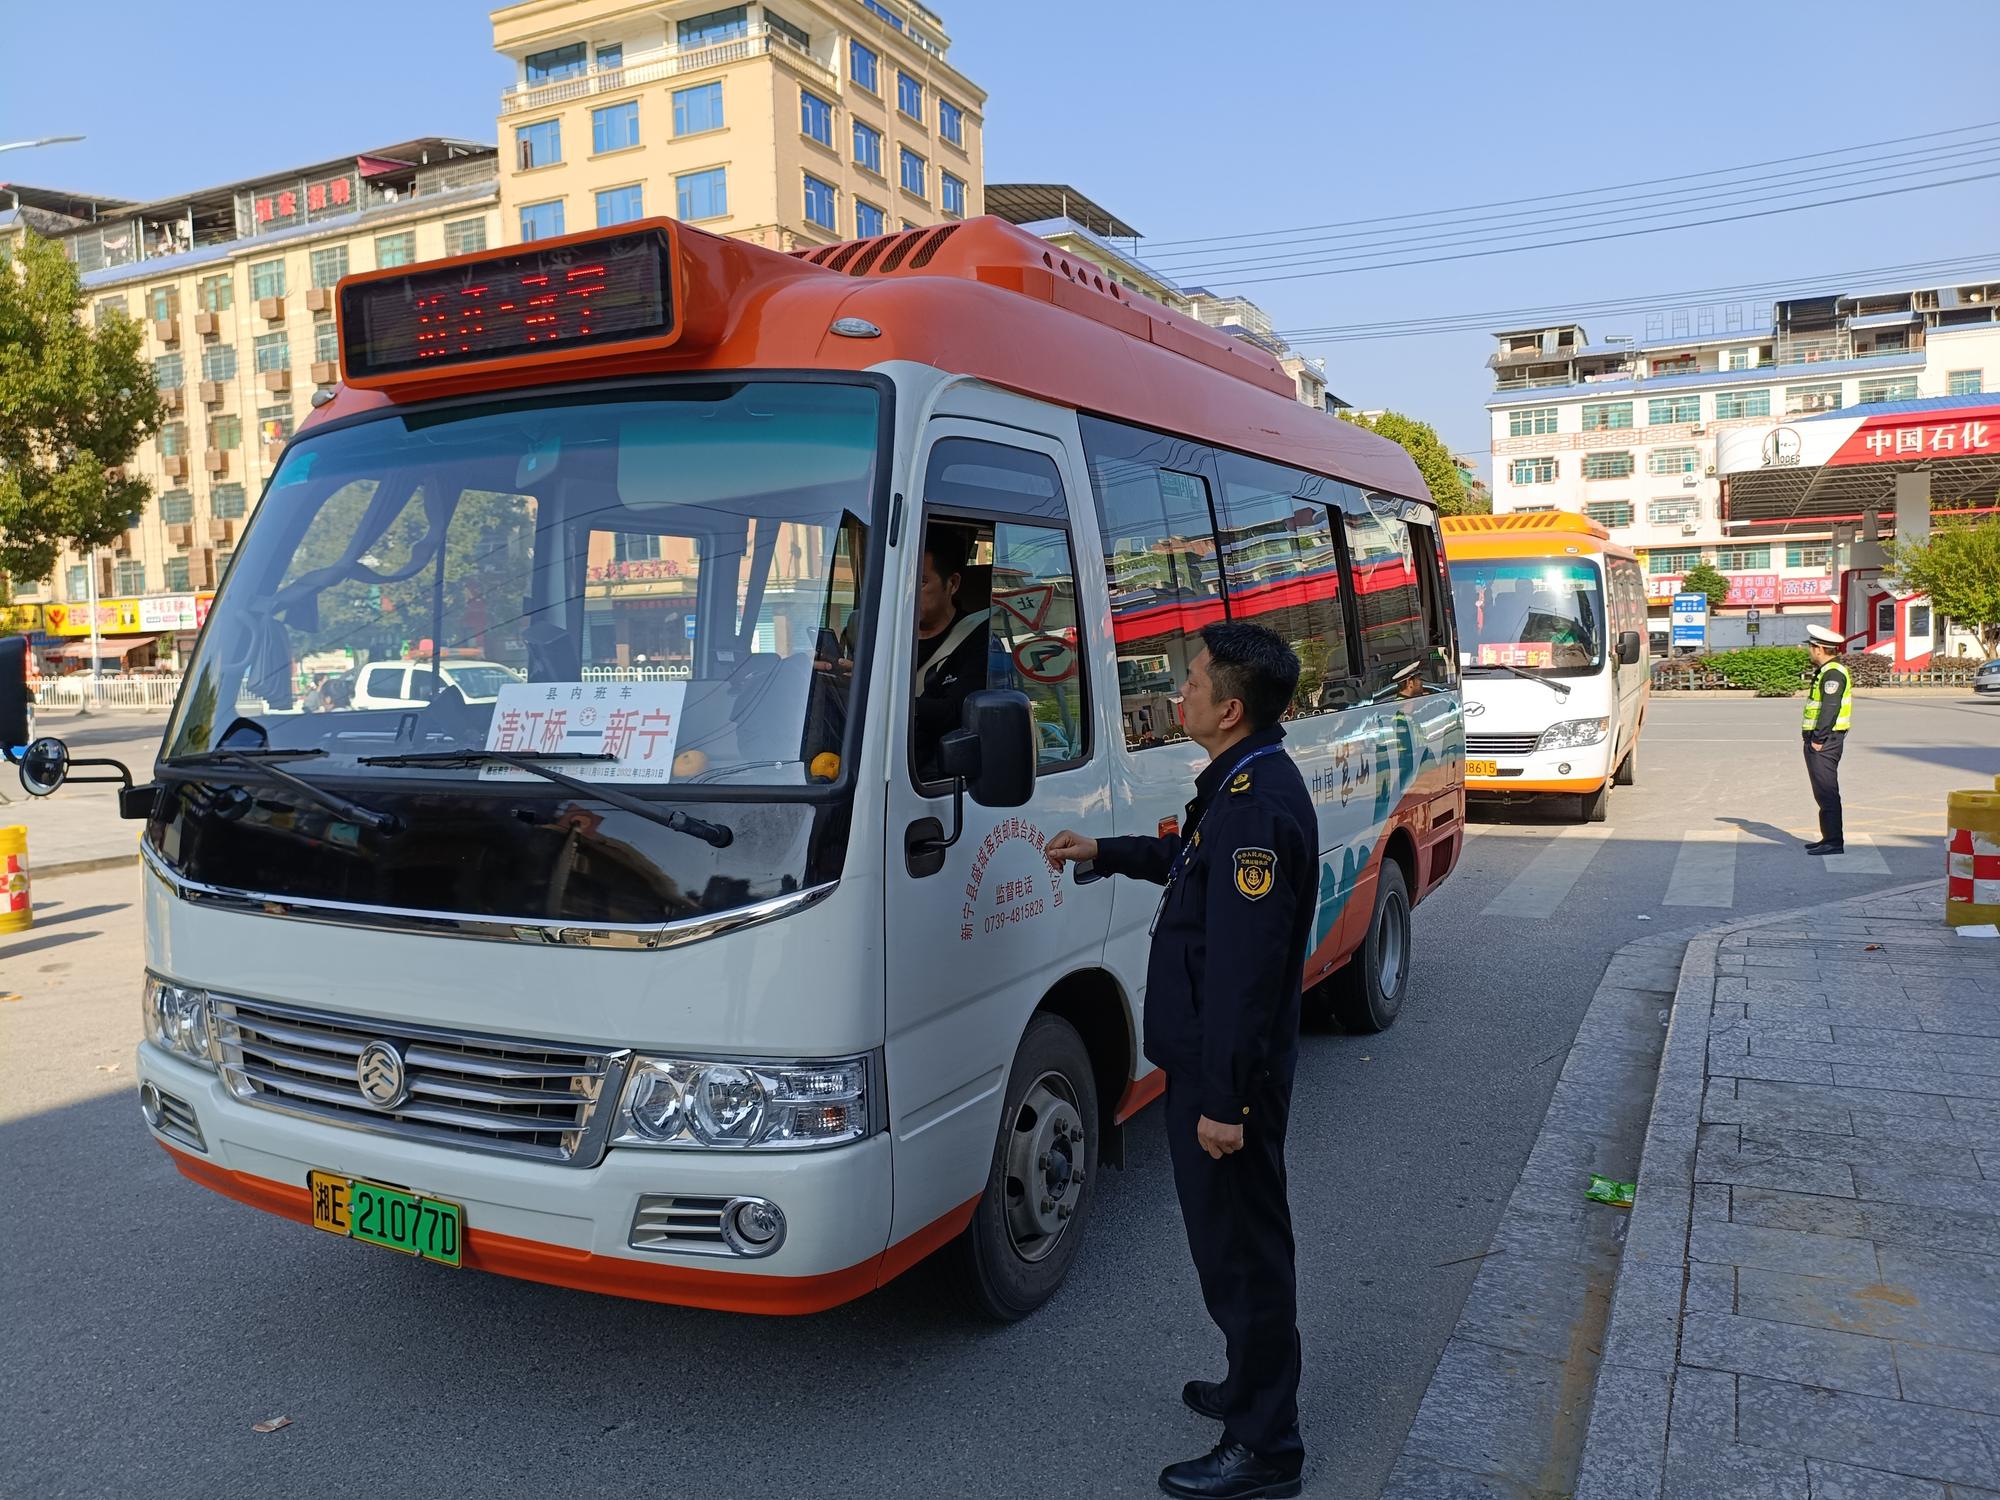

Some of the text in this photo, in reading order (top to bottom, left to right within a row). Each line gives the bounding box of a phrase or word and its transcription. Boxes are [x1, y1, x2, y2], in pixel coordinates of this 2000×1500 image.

[1866, 421, 1990, 457] 中国石化
[545, 685, 632, 701] 县内班车
[995, 875, 1033, 906] 监督电话
[984, 898, 1045, 933] 0739-4815828
